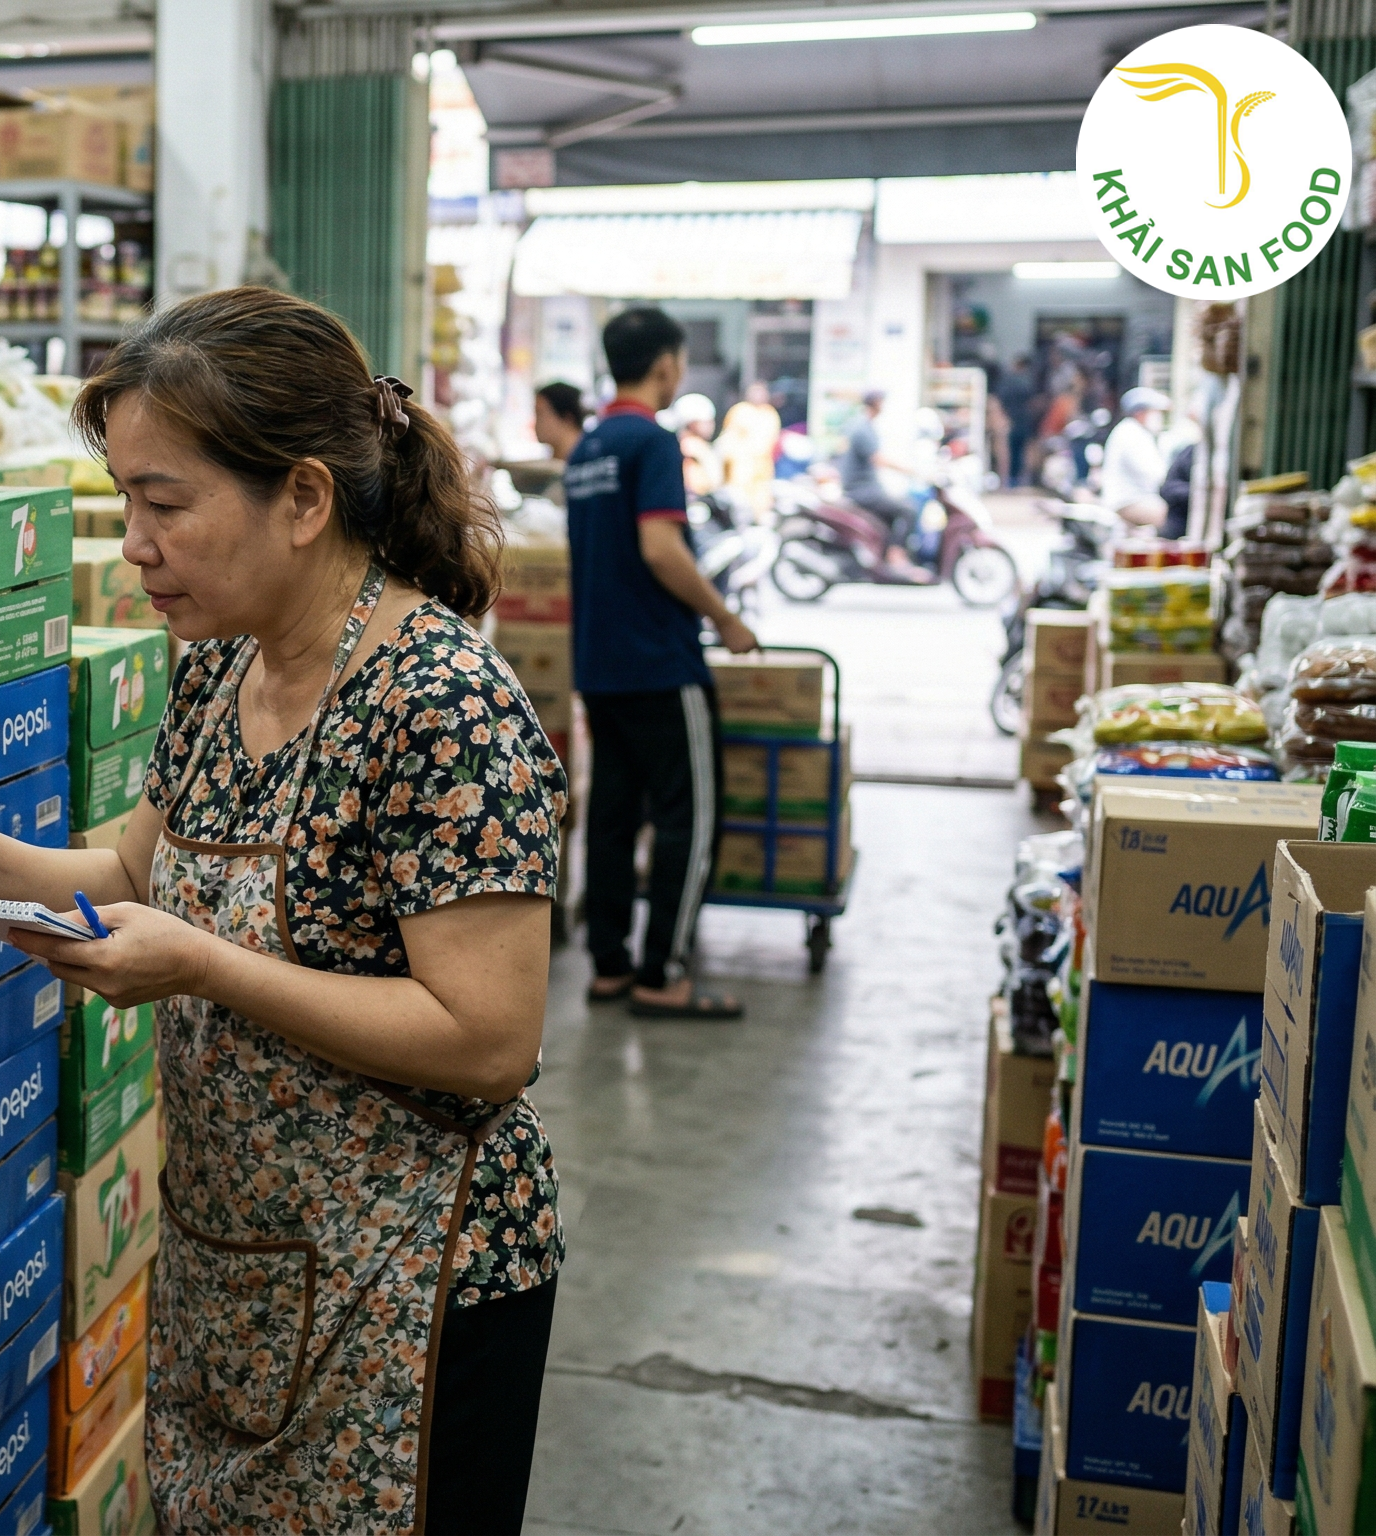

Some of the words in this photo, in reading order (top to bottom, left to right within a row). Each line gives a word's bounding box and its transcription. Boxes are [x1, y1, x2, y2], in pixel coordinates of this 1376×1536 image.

[2, 698, 48, 756] pepsi
[1143, 1015, 1263, 1108] AQUA
[0, 1062, 42, 1136] pepsi
[2, 1240, 47, 1310] pepsi
